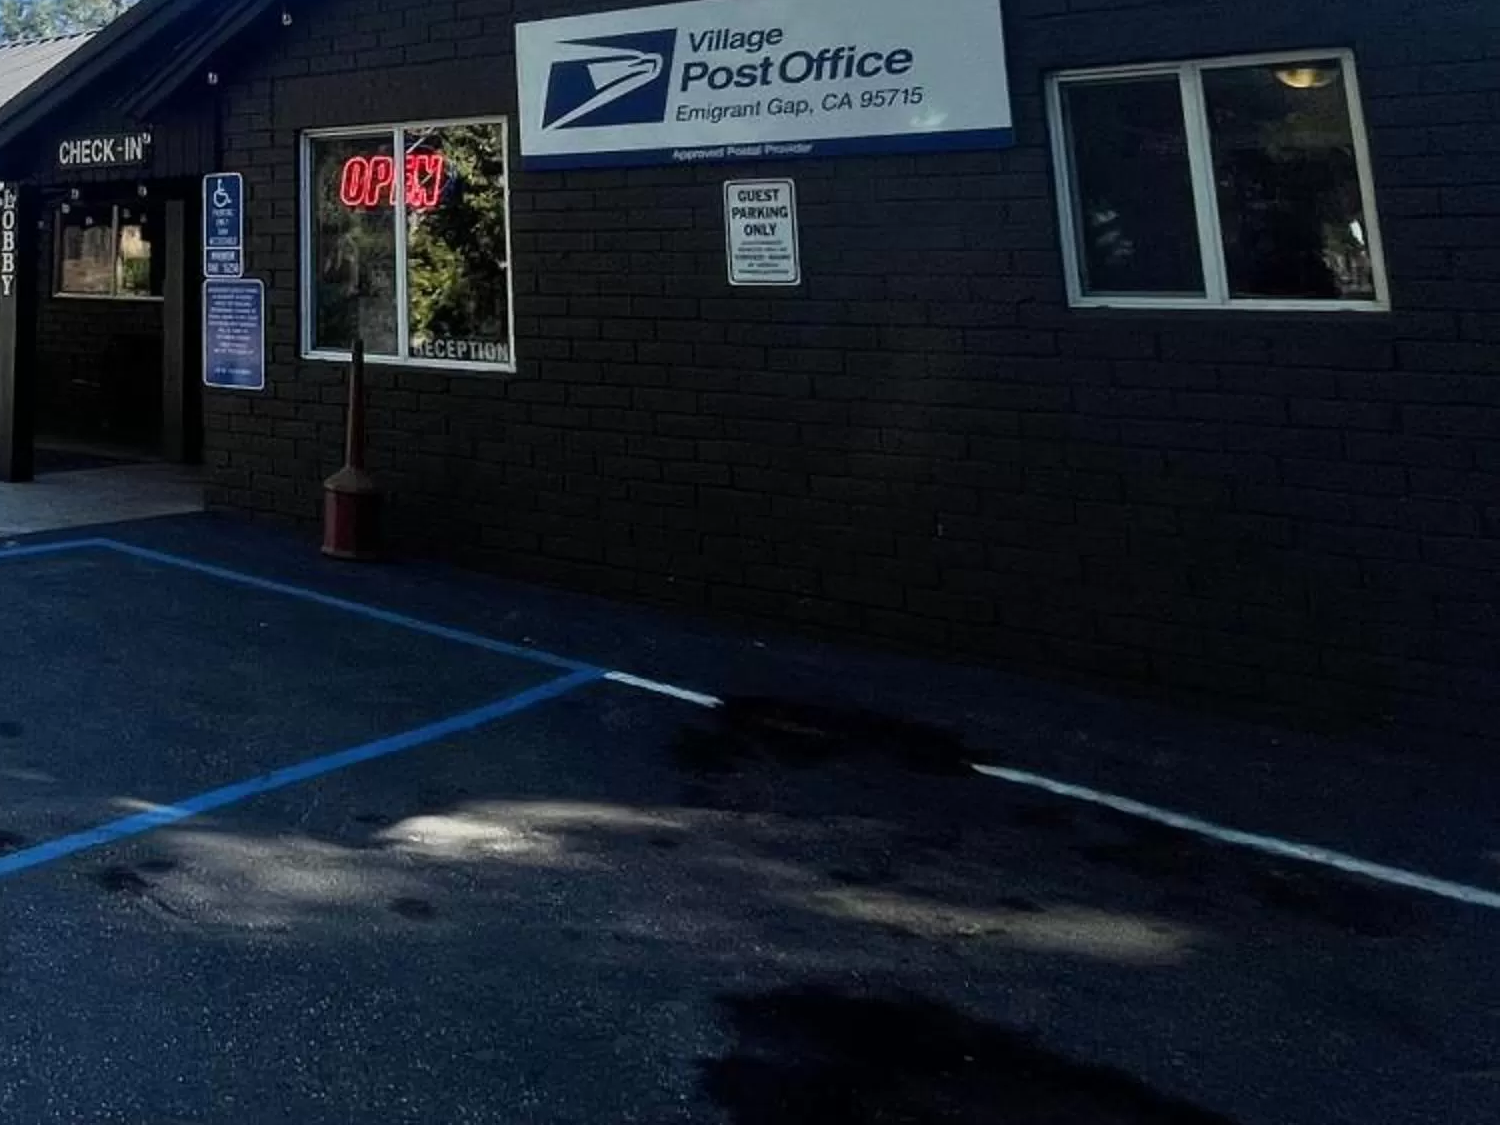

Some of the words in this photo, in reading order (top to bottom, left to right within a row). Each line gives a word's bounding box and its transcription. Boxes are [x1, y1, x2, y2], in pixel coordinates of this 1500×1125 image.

[689, 27, 783, 53] Village
[680, 56, 774, 92] Post
[779, 46, 913, 84] Office
[676, 101, 761, 124] Emigrant
[767, 97, 814, 117] Gap,
[821, 92, 853, 112] CA
[860, 86, 923, 108] 95715
[59, 136, 143, 165] CHECK-IN
[339, 154, 445, 207] OPEN
[737, 188, 780, 202] GUEST
[731, 206, 788, 219] PARKING
[1, 188, 16, 295] LOBBY
[743, 223, 777, 236] ONLY
